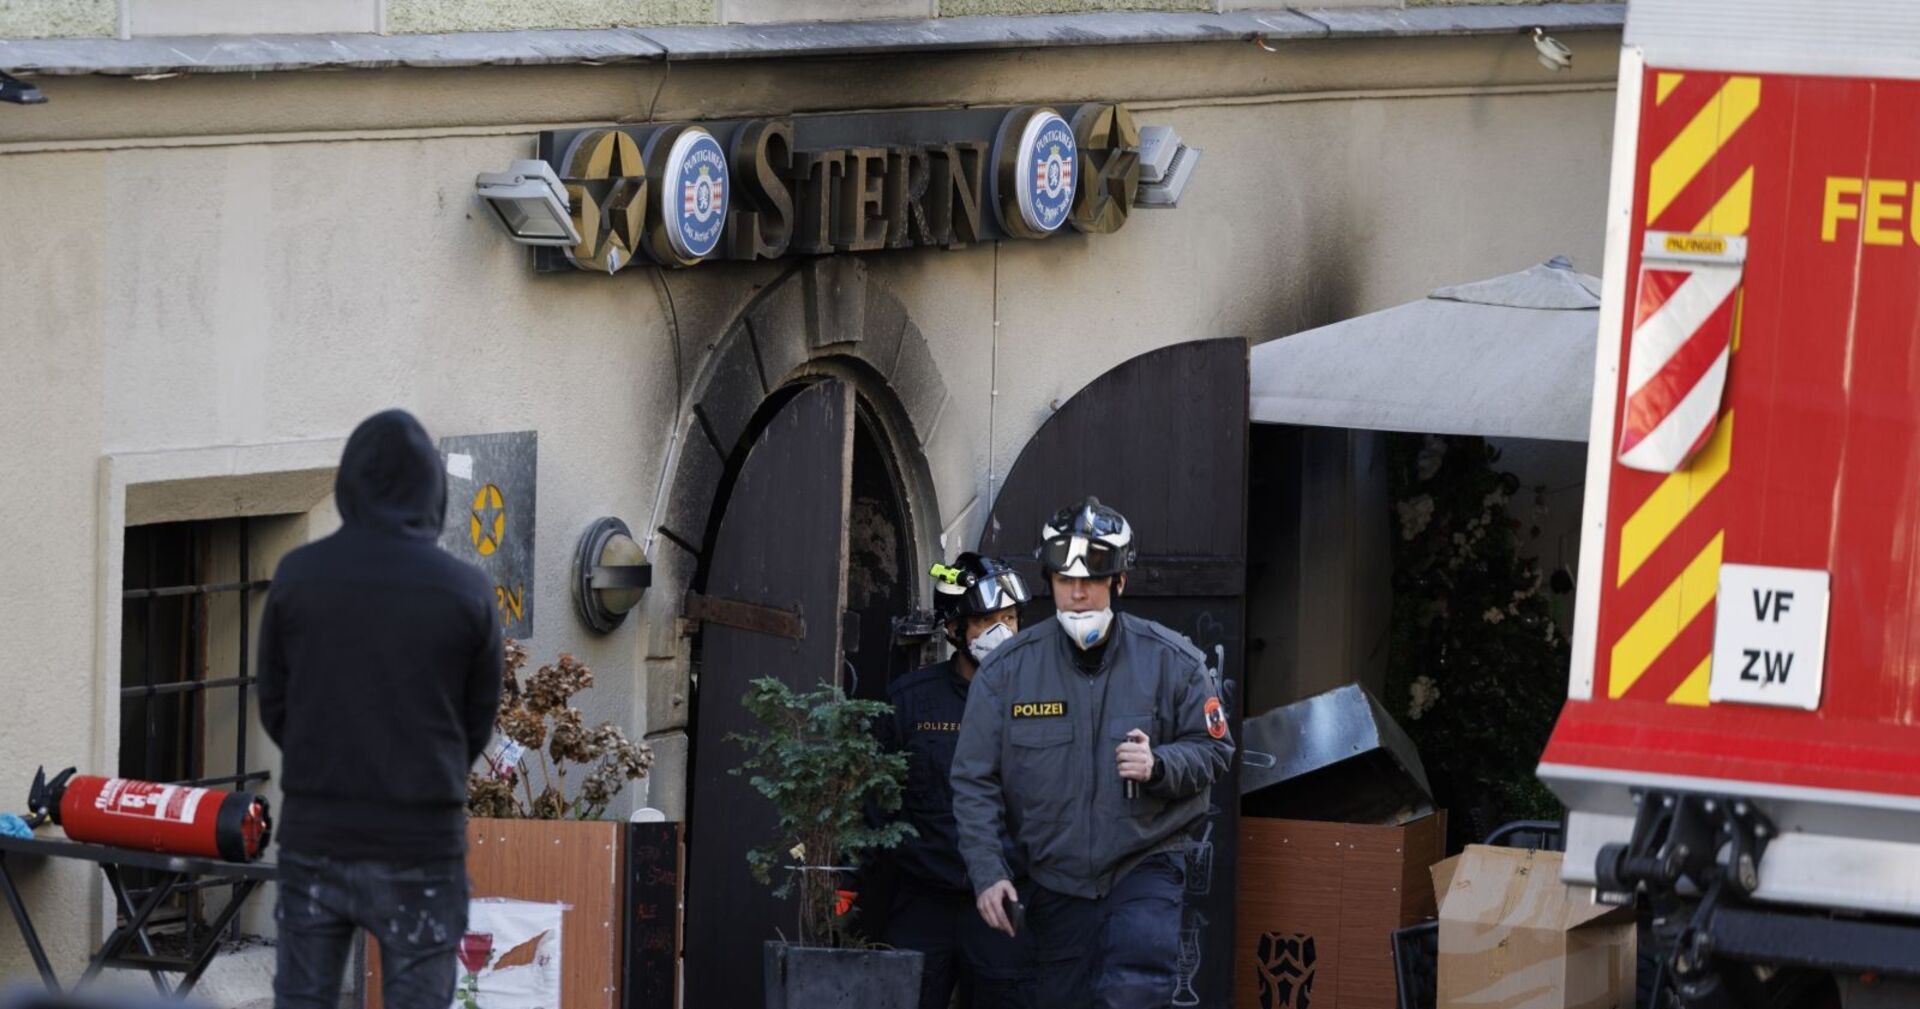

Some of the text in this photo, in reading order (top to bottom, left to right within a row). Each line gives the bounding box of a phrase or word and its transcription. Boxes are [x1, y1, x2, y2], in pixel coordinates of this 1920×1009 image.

[731, 119, 989, 261] STERN
[1821, 176, 1920, 246] FE
[1753, 588, 1794, 623] VF
[1740, 649, 1794, 684] ZW
[1013, 703, 1063, 717] POLIZEI
